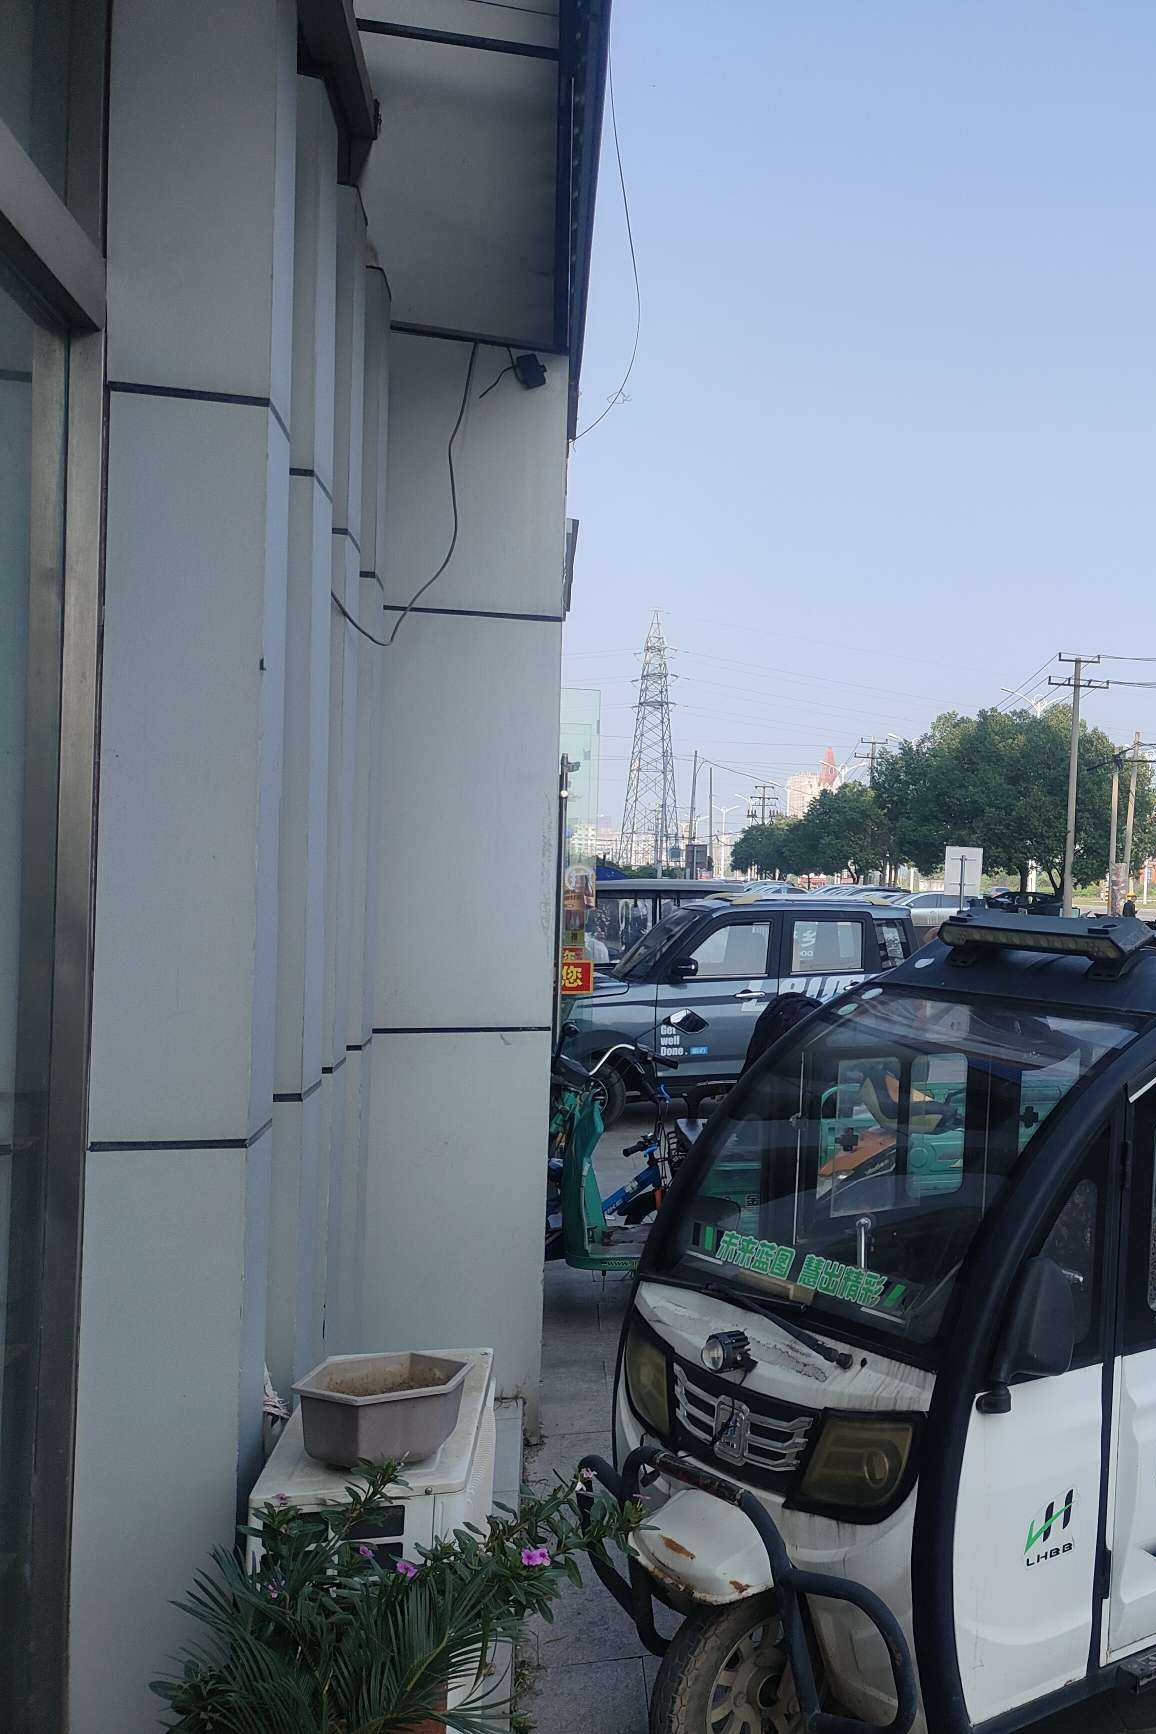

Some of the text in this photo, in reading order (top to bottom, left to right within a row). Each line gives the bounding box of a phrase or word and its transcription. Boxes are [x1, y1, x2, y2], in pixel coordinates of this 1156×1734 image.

[660, 1035, 680, 1046] well
[716, 1230, 888, 1307] 未来蓝图 慧出精彩
[1026, 1542, 1073, 1567] LHBB
